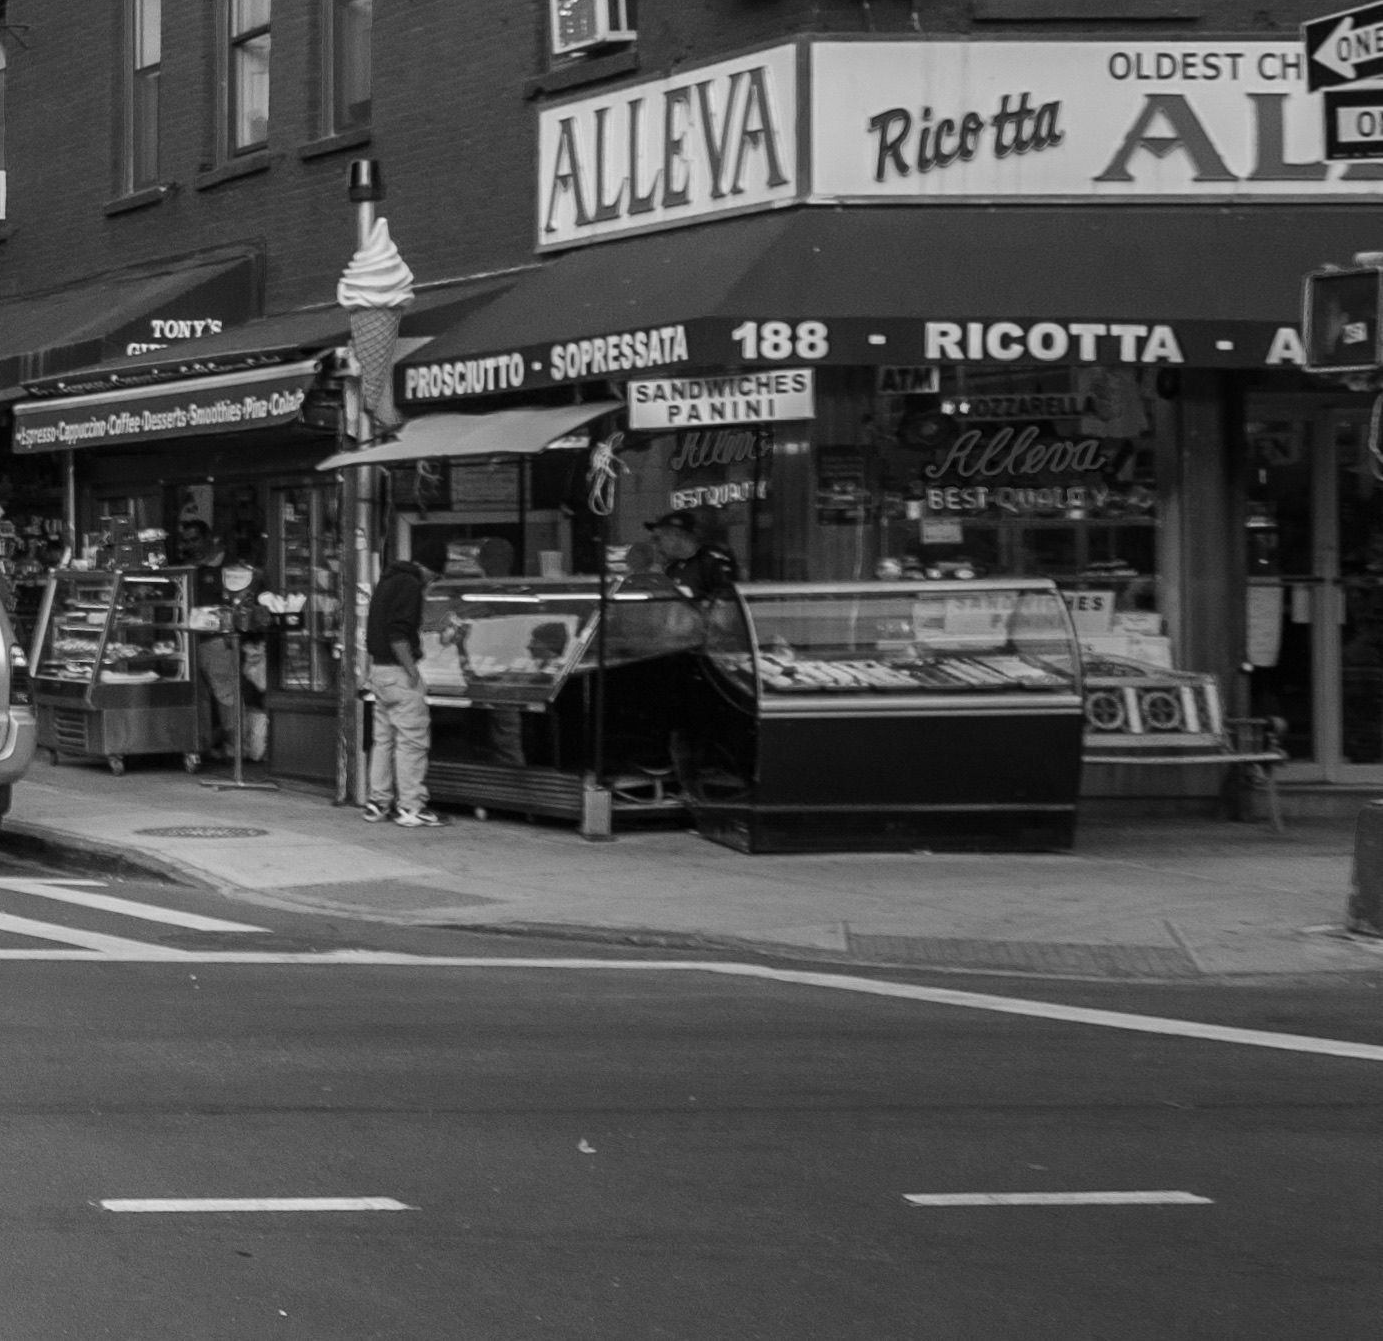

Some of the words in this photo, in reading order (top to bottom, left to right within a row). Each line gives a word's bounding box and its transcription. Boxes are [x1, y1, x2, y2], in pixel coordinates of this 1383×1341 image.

[1109, 52, 1240, 81] OLDEST
[1258, 52, 1302, 81] CH
[544, 66, 788, 233] ALLEVA
[867, 91, 1066, 182] Ricotta
[1093, 92, 1383, 183] AL
[151, 318, 223, 339] TONY'S
[732, 321, 829, 360] 188
[924, 321, 1185, 364] RICOTTA
[405, 353, 525, 400] PROSCIUTTO
[551, 325, 689, 380] SOPRESSATA
[635, 372, 809, 404] SANDWICHES
[883, 367, 931, 393] ATM
[58, 417, 106, 444] Cappuccino
[108, 413, 140, 435] Coffee
[143, 408, 187, 430] Desserts
[188, 400, 241, 426] Smoothies
[666, 396, 776, 423] PANINI
[961, 395, 1097, 417] OZZARELLA
[925, 425, 1107, 479] Alleva
[925, 485, 989, 510] BEST
